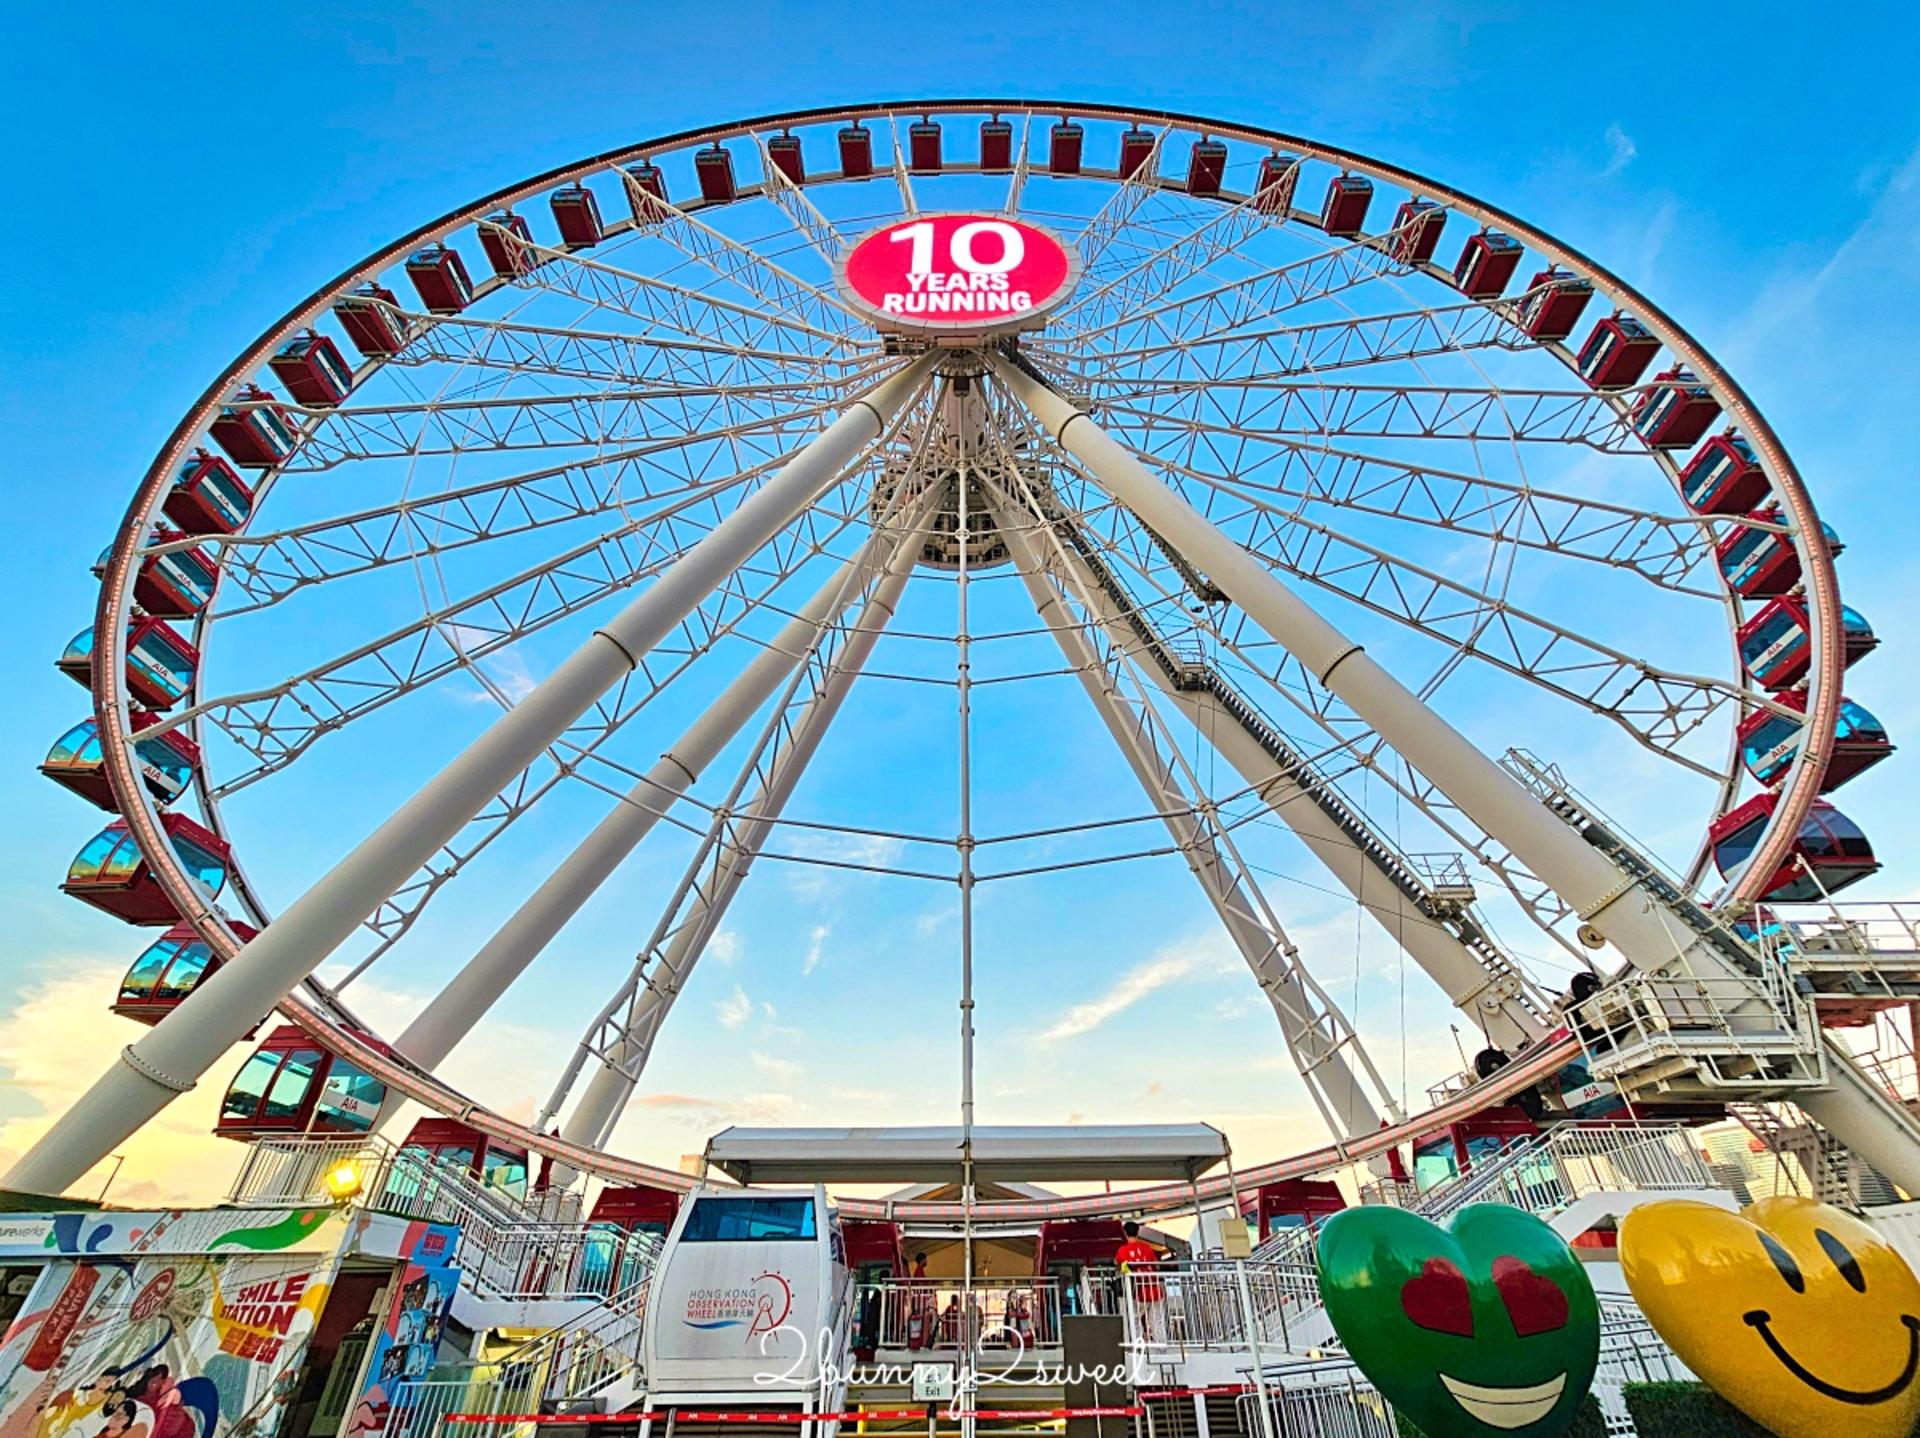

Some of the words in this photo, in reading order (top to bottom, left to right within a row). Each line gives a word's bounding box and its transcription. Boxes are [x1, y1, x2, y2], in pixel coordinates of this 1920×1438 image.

[890, 222, 1025, 274] 10
[906, 272, 1010, 292] YEARS
[882, 290, 1033, 313] RUNNING
[1767, 642, 1783, 657] AIA
[151, 662, 168, 678] AIA
[1771, 744, 1789, 759] AIA
[142, 765, 161, 782] AIA
[1583, 1084, 1601, 1100] AIA
[340, 1097, 358, 1113] AIA
[236, 1272, 312, 1304] SMILE
[689, 1288, 722, 1299] HONG
[724, 1288, 757, 1299] KONG
[687, 1299, 755, 1309] OBSERVATION
[219, 1303, 299, 1336] STATION
[687, 1308, 717, 1319] WHEEL
